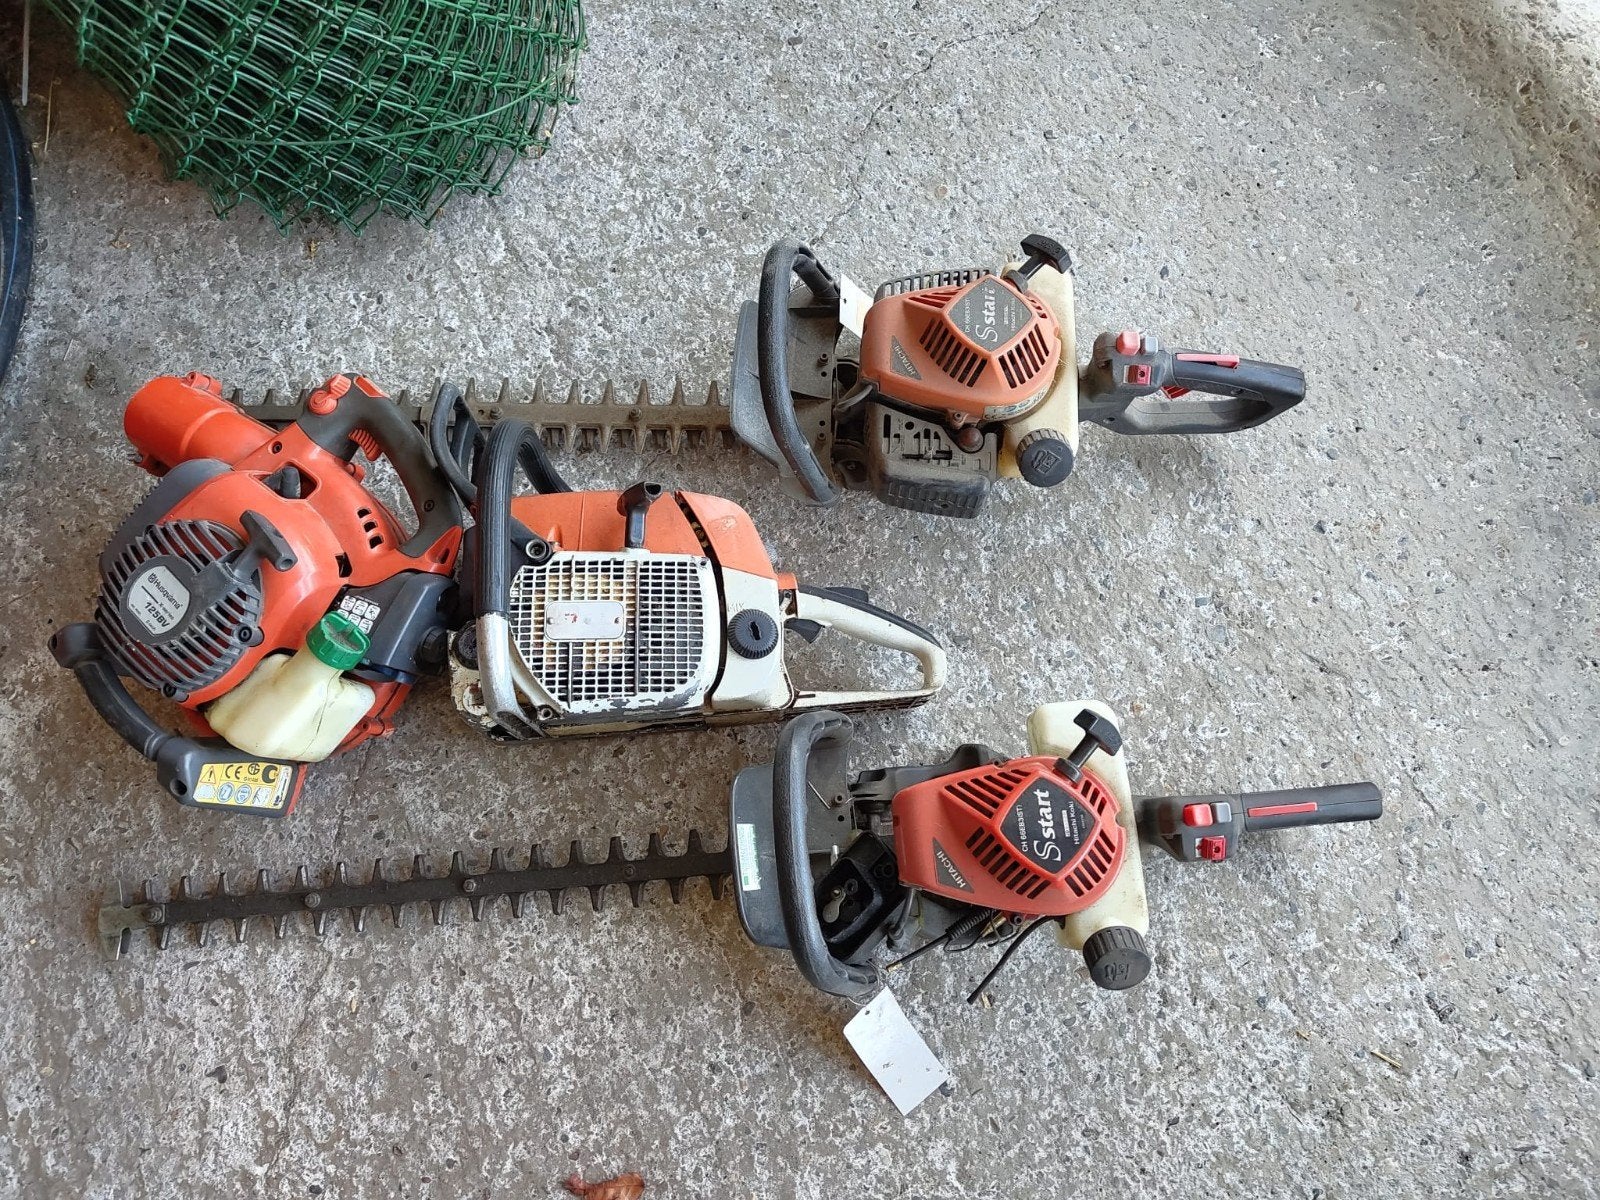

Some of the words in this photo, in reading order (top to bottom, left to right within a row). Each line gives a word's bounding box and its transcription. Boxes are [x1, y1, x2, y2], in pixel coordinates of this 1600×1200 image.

[144, 602, 170, 628] 125BV
[1033, 788, 1056, 840] start
[1068, 801, 1076, 818] Koki
[1071, 818, 1080, 845] Hitachi
[1021, 841, 1029, 852] CH
[936, 850, 966, 888] HITACHI
